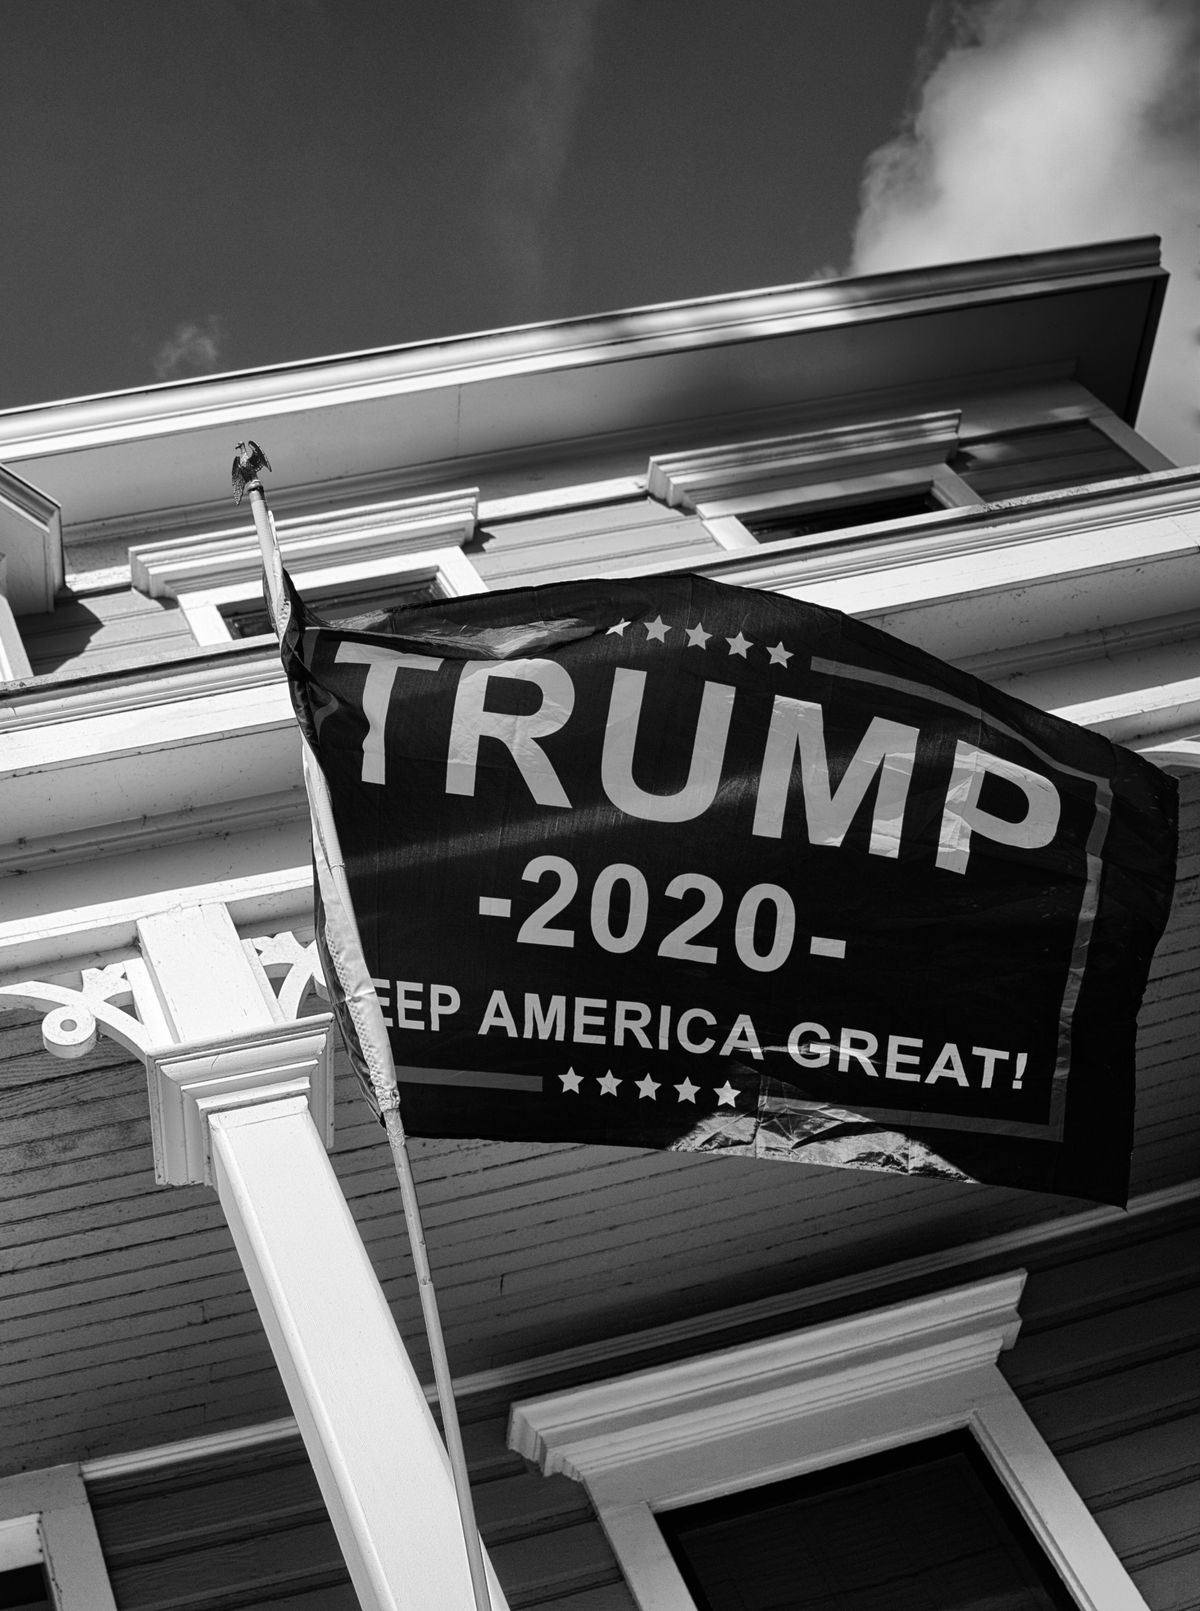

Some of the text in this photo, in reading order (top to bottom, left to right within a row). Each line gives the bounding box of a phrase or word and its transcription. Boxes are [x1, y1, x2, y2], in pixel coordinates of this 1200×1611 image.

[335, 642, 1061, 875] TRUMP
[479, 855, 846, 972] -2020-
[372, 978, 1028, 1090] EEP AMERICA GREAT!
